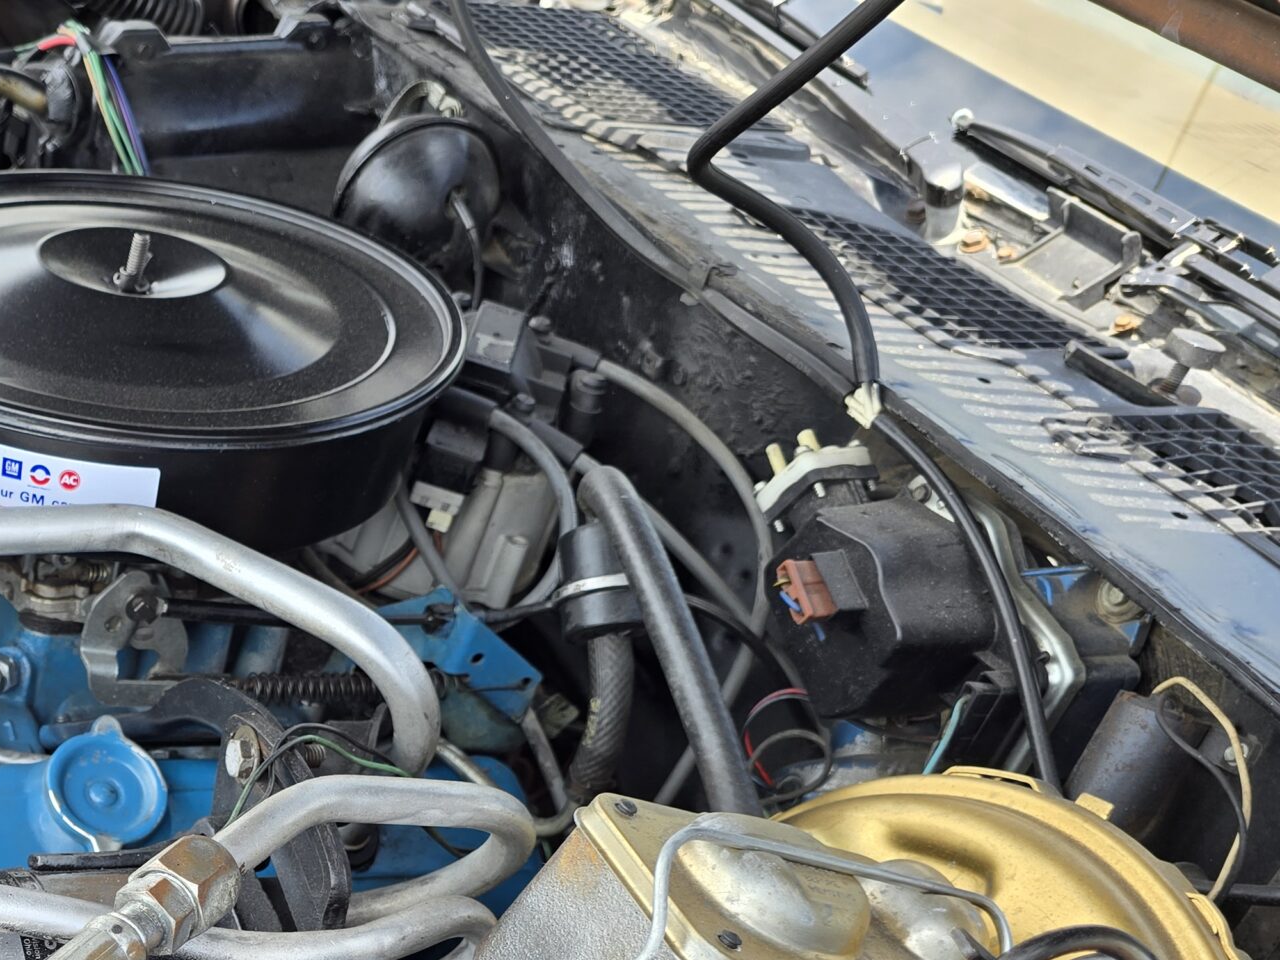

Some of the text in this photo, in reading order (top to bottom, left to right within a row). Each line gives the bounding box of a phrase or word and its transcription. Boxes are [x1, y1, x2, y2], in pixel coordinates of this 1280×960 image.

[4, 459, 21, 477] GM
[60, 473, 79, 488] AC
[20, 491, 45, 506] GM
[23, 938, 32, 956] Ohio
